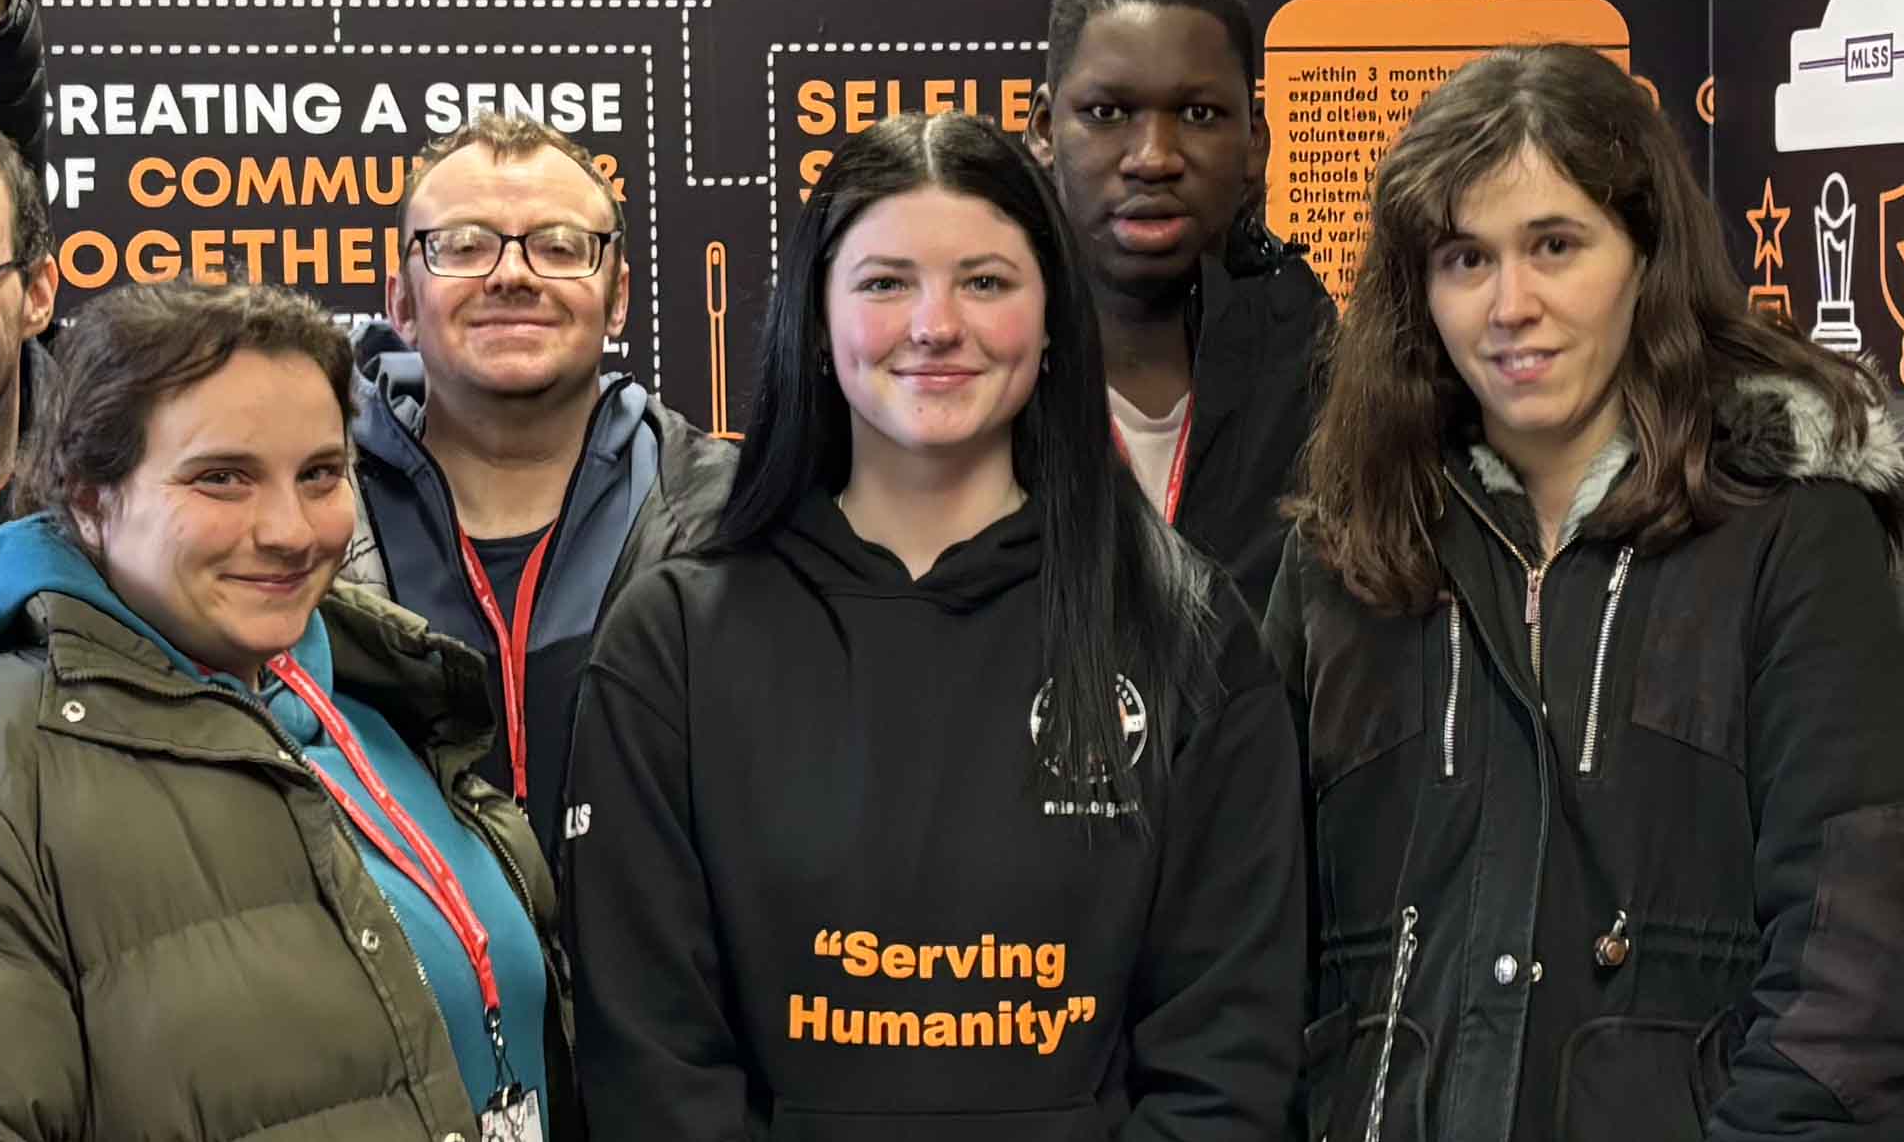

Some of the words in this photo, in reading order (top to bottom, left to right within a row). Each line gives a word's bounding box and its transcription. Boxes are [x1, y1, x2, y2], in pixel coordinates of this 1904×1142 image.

[1851, 45, 1888, 69] MLSS
[1368, 67, 1377, 82] 3
[1289, 86, 1378, 106] expanded
[1390, 88, 1409, 102] to
[43, 83, 342, 134] REATING
[360, 83, 408, 134] A
[424, 82, 622, 134] SENSE
[1289, 149, 1361, 166] support
[598, 155, 627, 203] &
[1289, 168, 1358, 183] schools
[1307, 207, 1345, 223] 24hr
